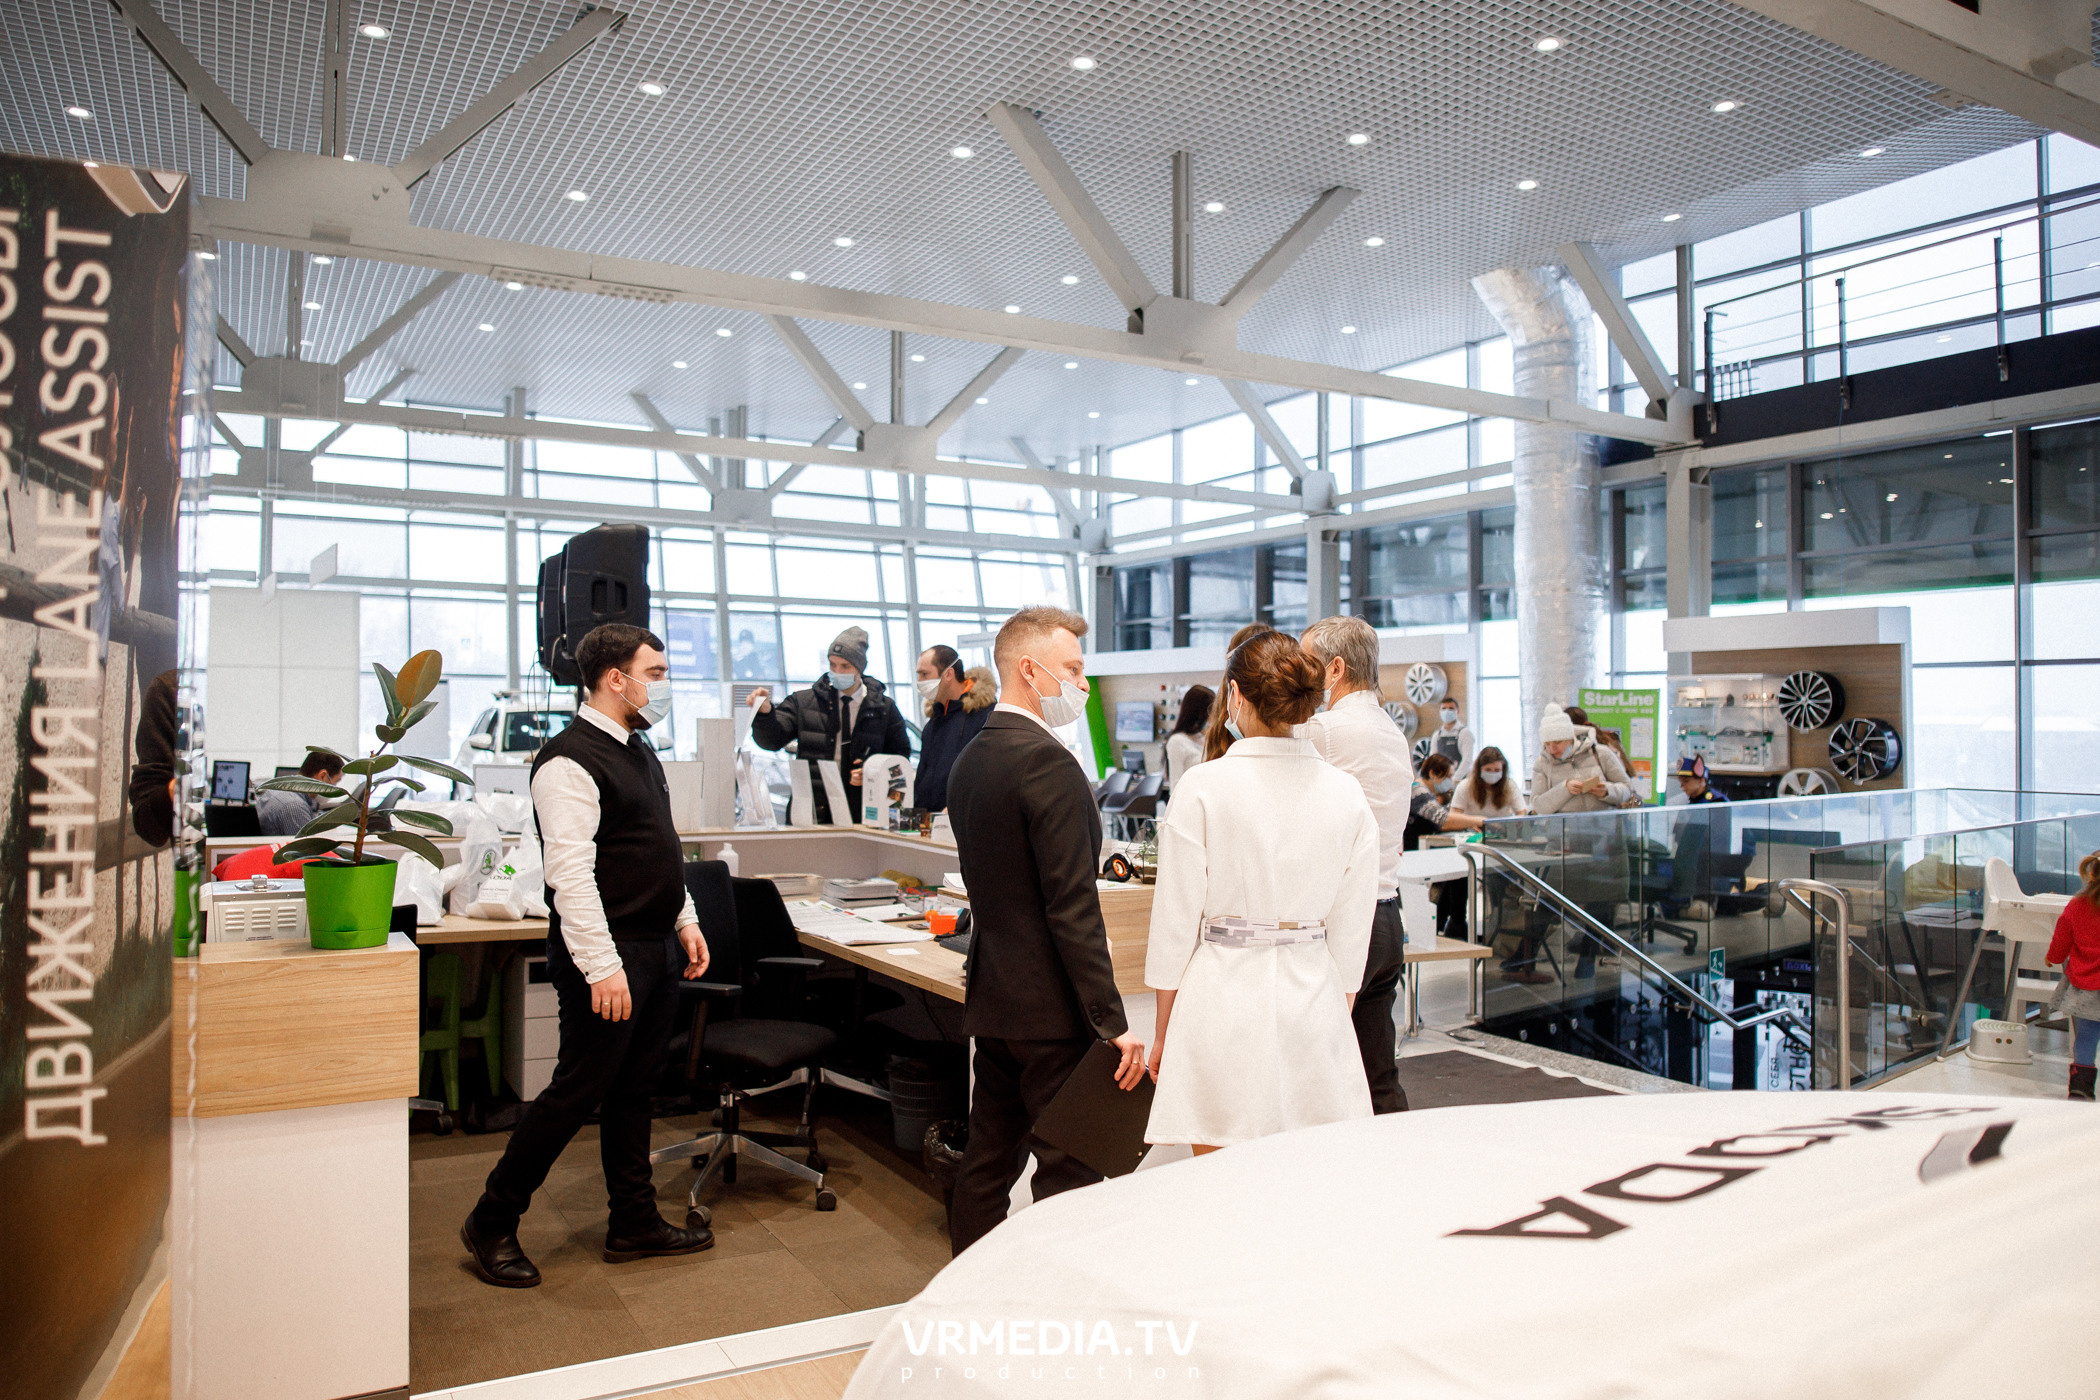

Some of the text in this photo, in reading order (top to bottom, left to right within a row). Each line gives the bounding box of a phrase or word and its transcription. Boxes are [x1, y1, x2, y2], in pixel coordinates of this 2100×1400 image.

[24, 208, 113, 1147] ДВИЖЕНИЯ LANE ASSIST
[1584, 691, 1654, 706] StarLine
